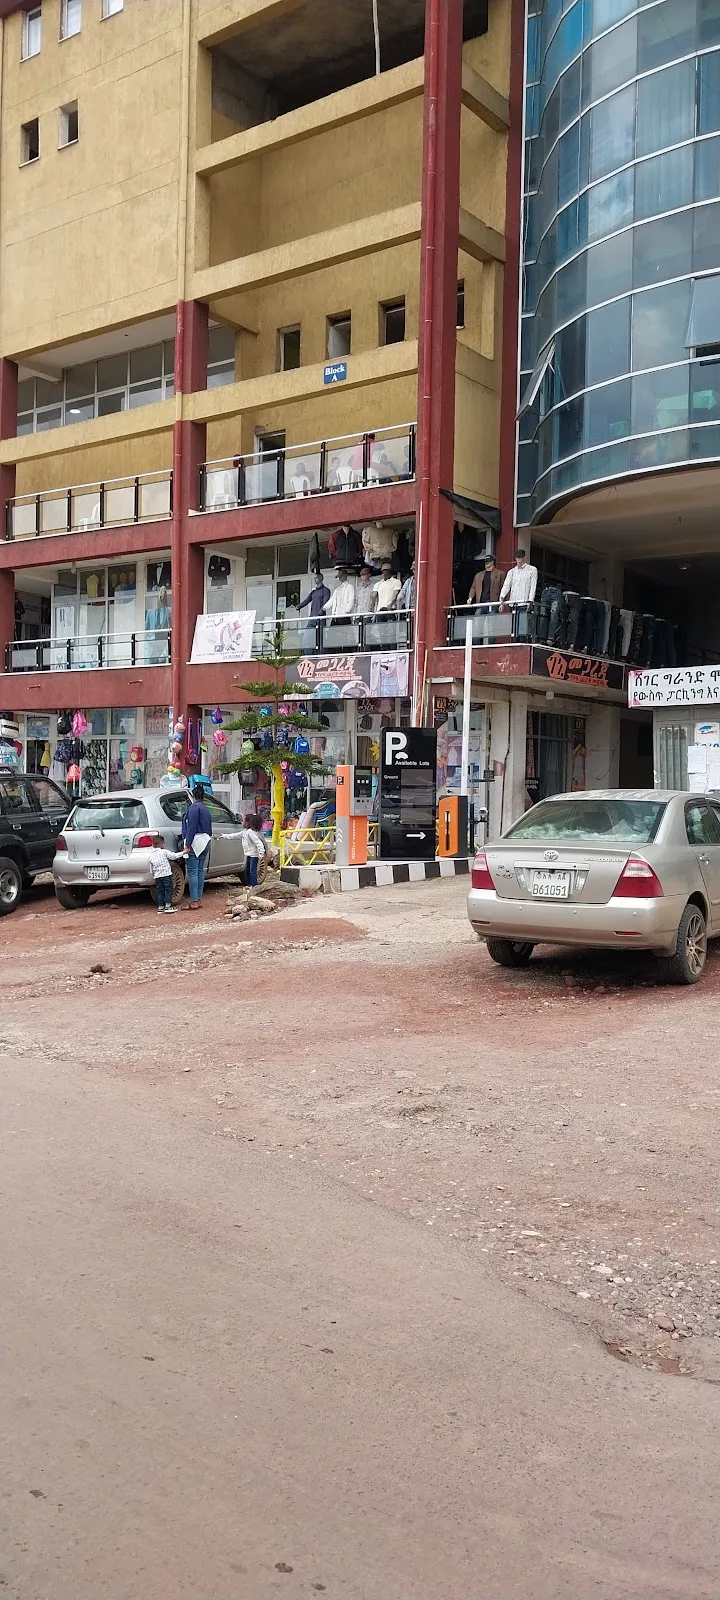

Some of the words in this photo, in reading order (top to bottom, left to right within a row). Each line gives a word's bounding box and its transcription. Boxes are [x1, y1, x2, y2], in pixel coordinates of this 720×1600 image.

[325, 365, 345, 375] Block
[331, 374, 338, 382] A
[635, 672, 659, 687] ሸገር
[663, 670, 705, 685] ግራንድ
[633, 689, 663, 702] የውስጥ
[666, 687, 704, 702] ፓርኪንግ
[707, 686, 720, 699] እና
[385, 731, 408, 766] P
[532, 883, 567, 896] B61051
